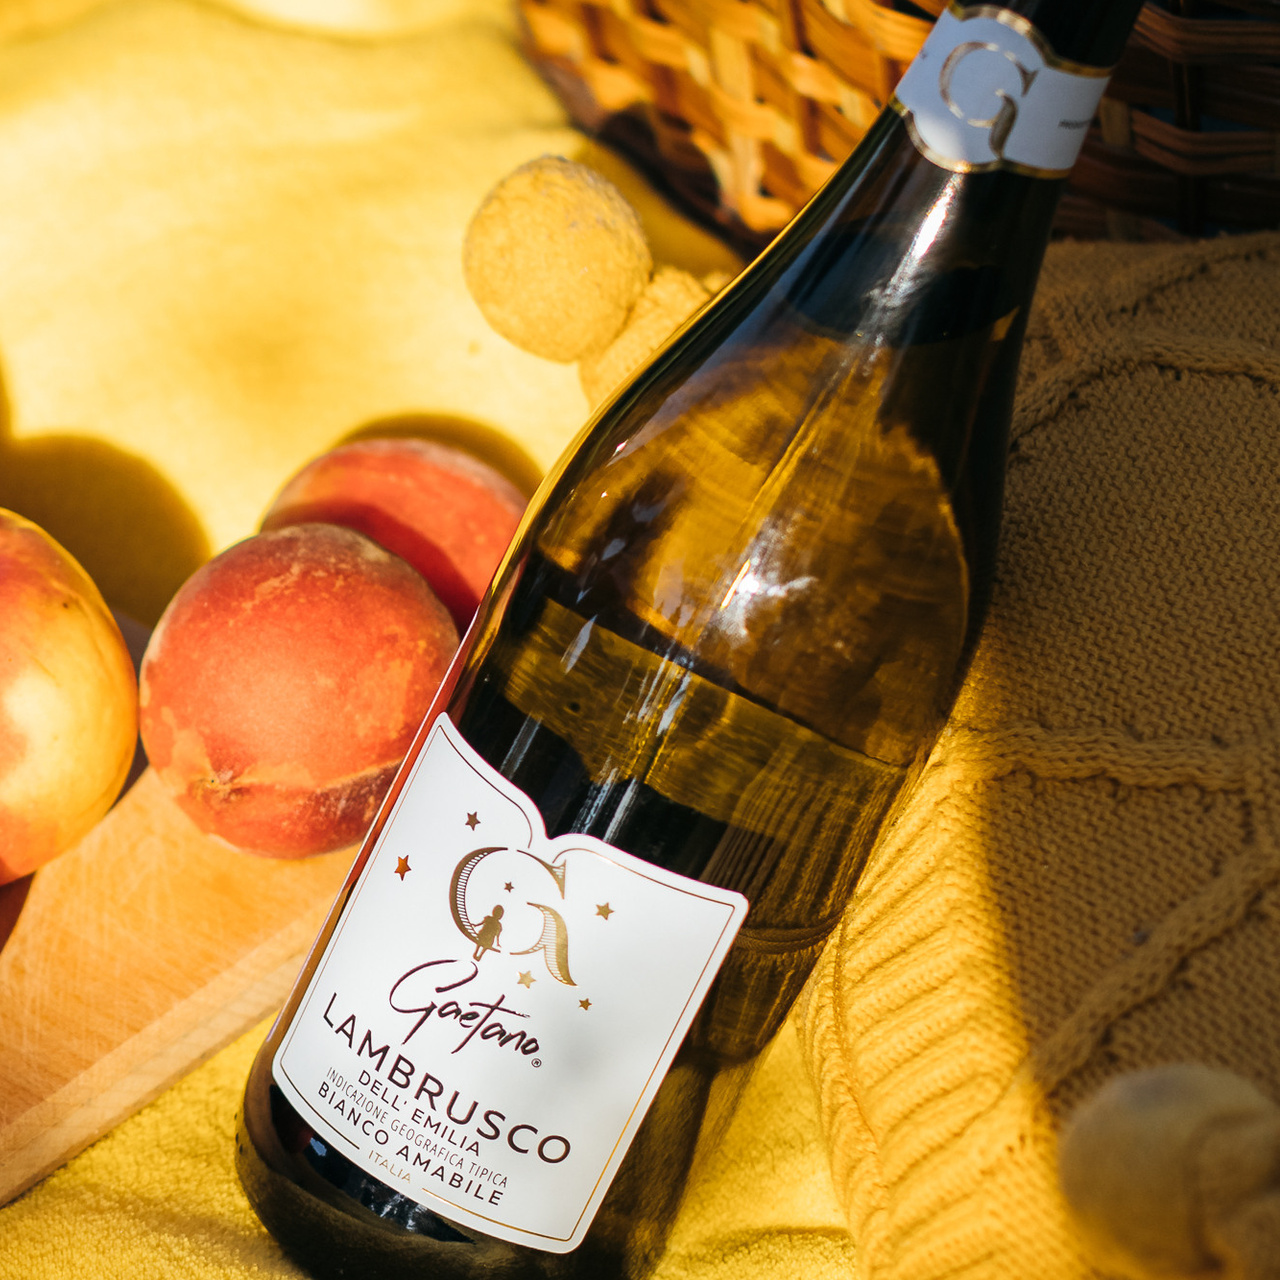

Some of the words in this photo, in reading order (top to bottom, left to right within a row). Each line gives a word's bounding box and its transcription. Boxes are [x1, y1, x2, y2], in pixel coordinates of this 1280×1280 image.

[323, 992, 571, 1164] LAMBRUSCO
[326, 1067, 388, 1123] INDICAZIONE
[390, 1119, 464, 1170] GEOGRAFICA
[470, 1161, 508, 1188] TIPICA
[358, 1070, 408, 1111] DELL'
[411, 1108, 480, 1157] EMILIA
[318, 1081, 389, 1145] BIANCO
[396, 1145, 504, 1206] AMABILE
[369, 1150, 411, 1184] ITALIA
